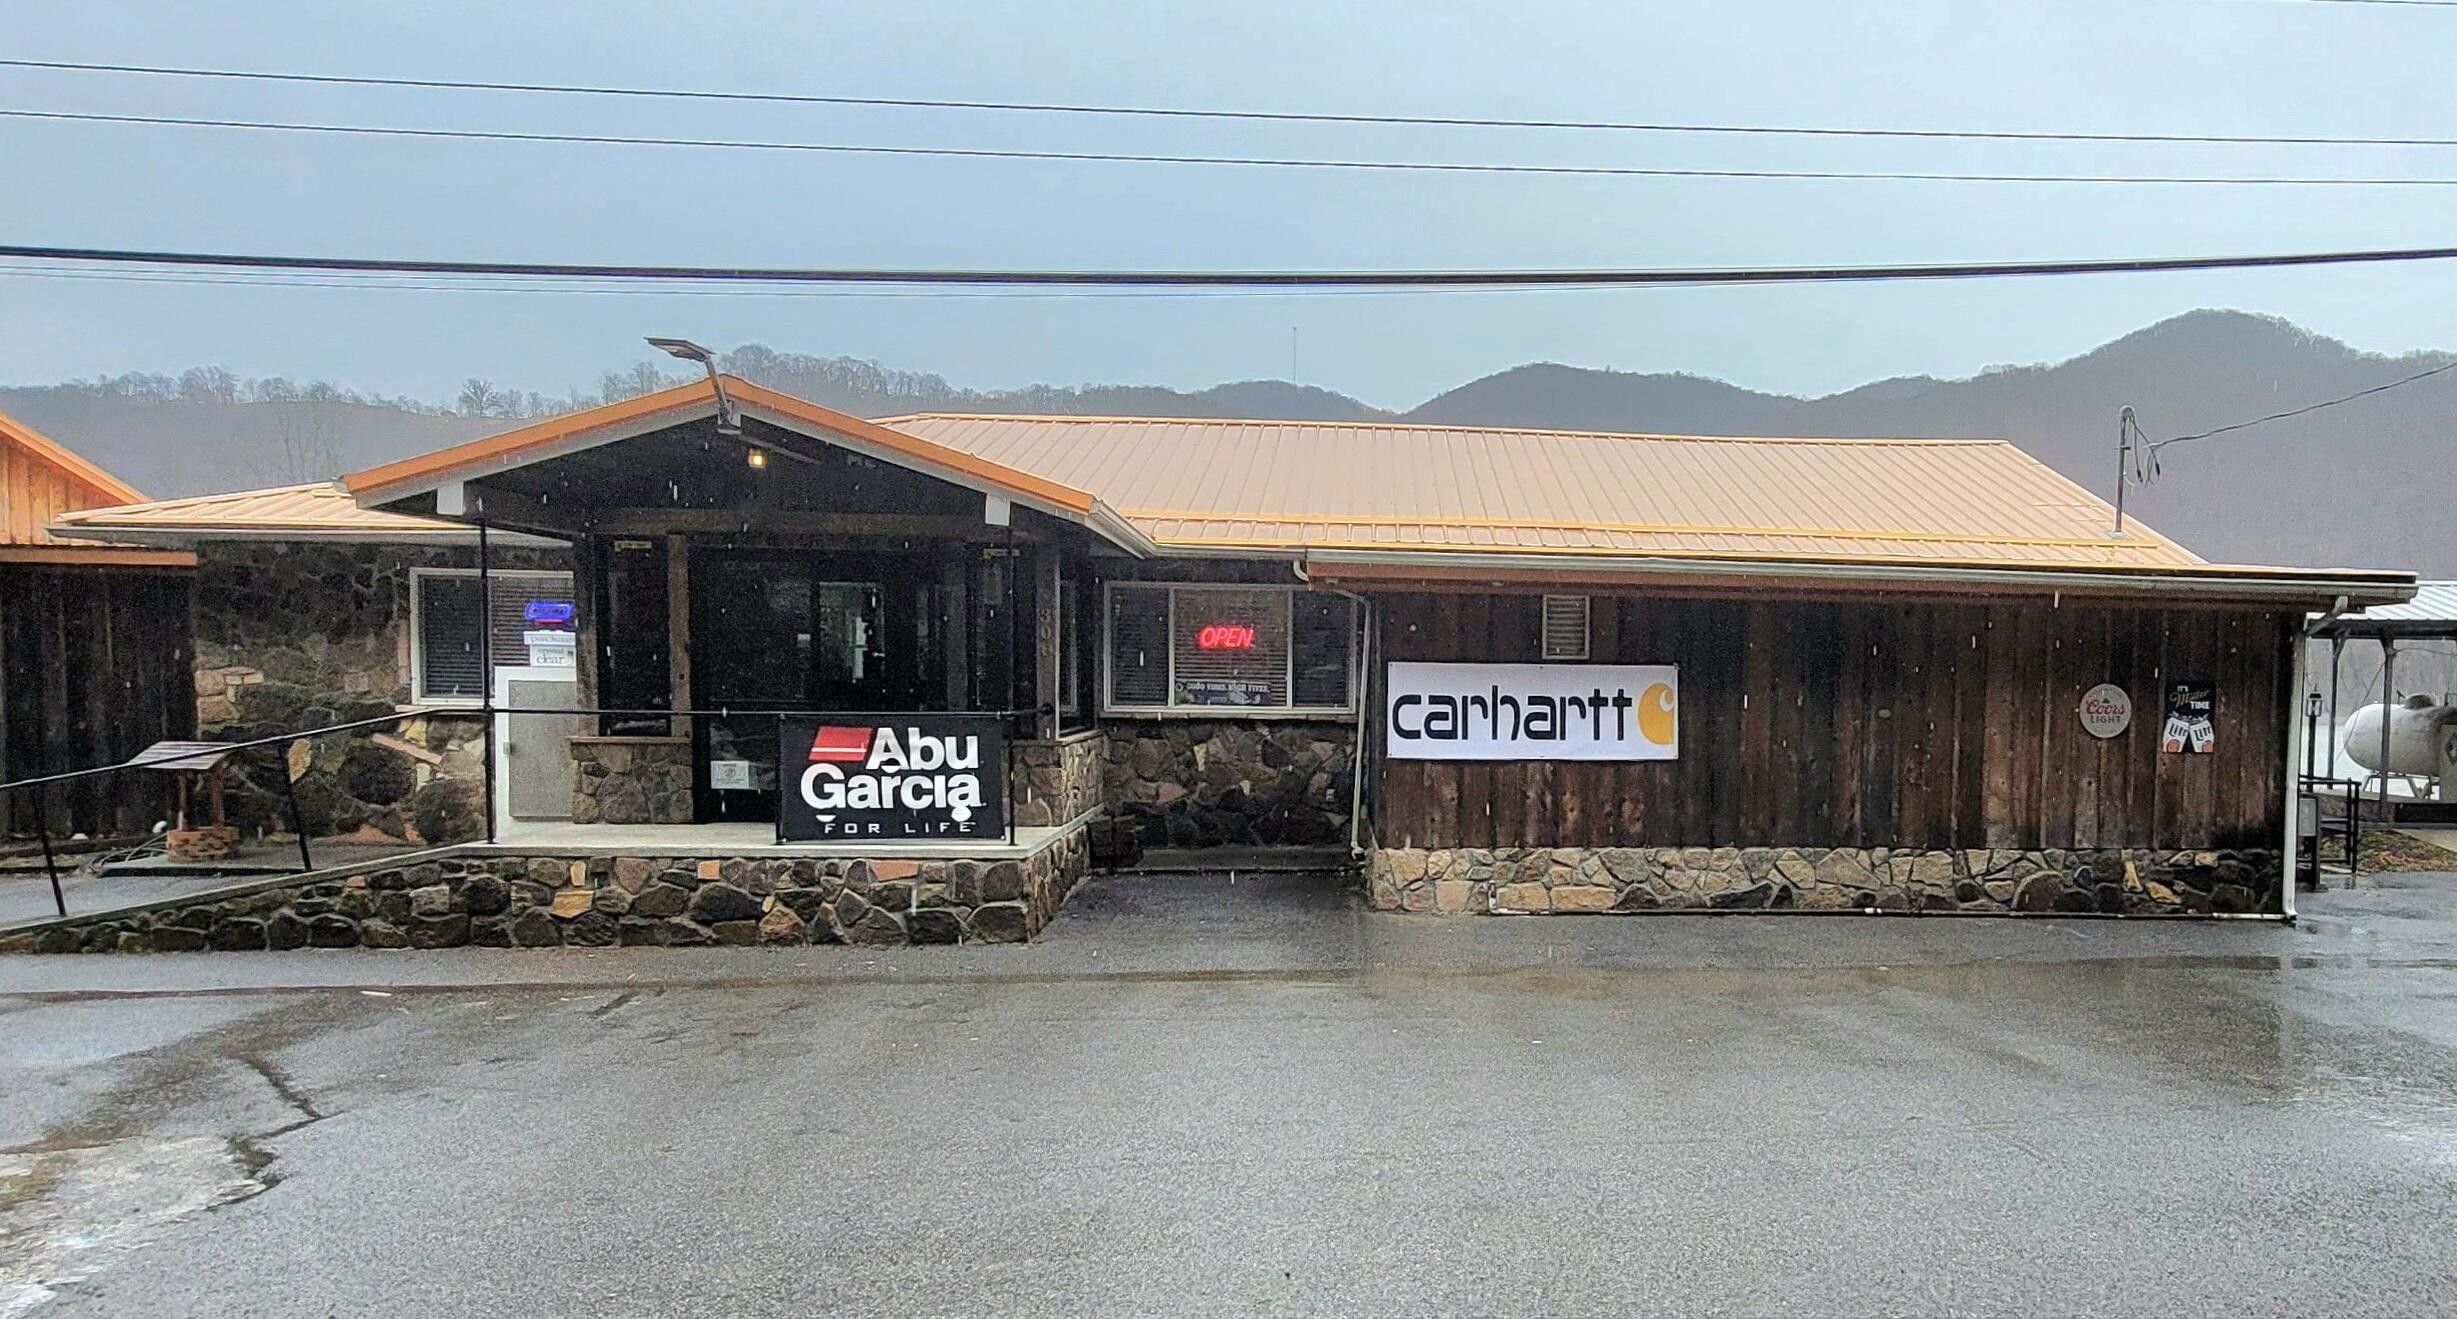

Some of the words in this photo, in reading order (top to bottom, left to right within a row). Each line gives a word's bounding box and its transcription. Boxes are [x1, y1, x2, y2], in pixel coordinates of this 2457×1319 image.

[1198, 625, 1254, 649] OPEN
[1392, 685, 1633, 741] carhartt
[2086, 700, 2125, 715] Coors
[2190, 701, 2210, 710] TIME
[2090, 715, 2121, 724] LIGHT
[865, 727, 980, 772] Abu
[800, 762, 984, 809] Garcia
[824, 823, 881, 834] FOR
[904, 822, 973, 834] LIFE
